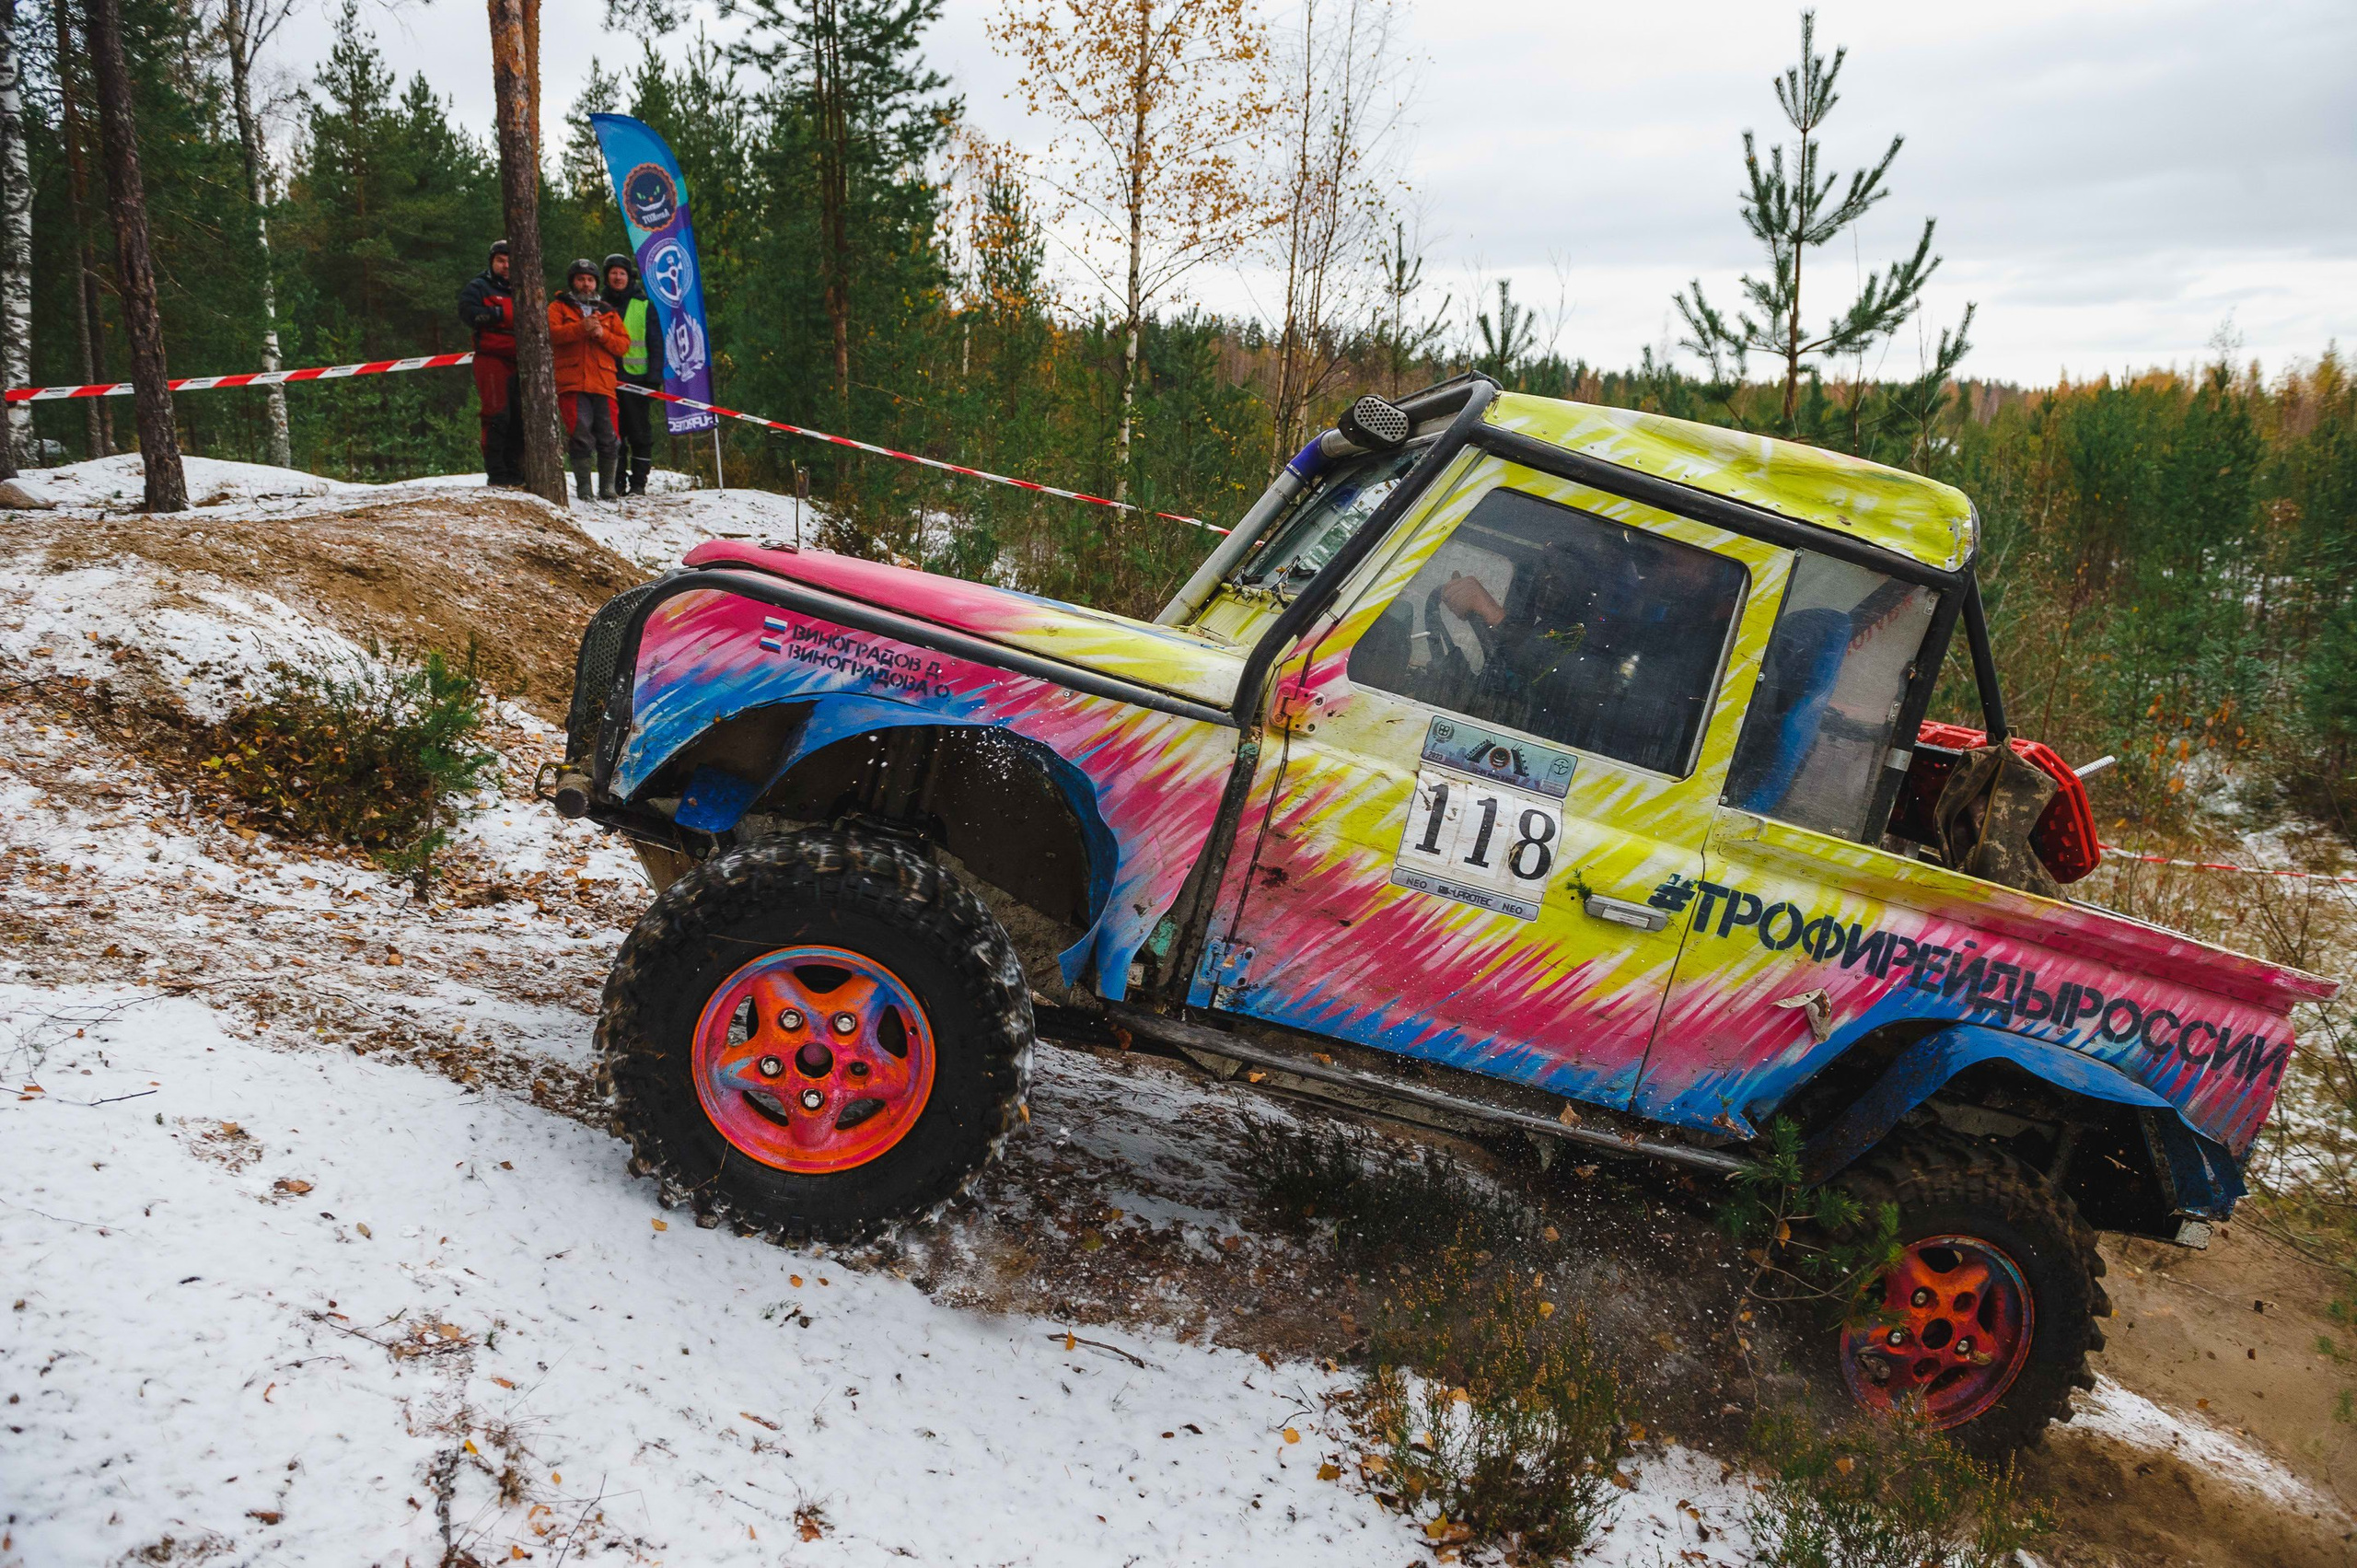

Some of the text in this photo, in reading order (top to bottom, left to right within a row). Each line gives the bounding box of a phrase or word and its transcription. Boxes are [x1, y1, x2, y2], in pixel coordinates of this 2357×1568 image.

[788, 644, 928, 695] ВИНОГРАДОВА
[793, 624, 921, 672] ВИНОГРАДОВ
[1428, 750, 1444, 761] 2023
[1415, 783, 1556, 880] 118
[1406, 877, 1427, 889] NEO
[1502, 901, 1523, 915] NEO
[1647, 871, 2290, 1087] #ТРОФИРЕЙДЫРОССИИ
